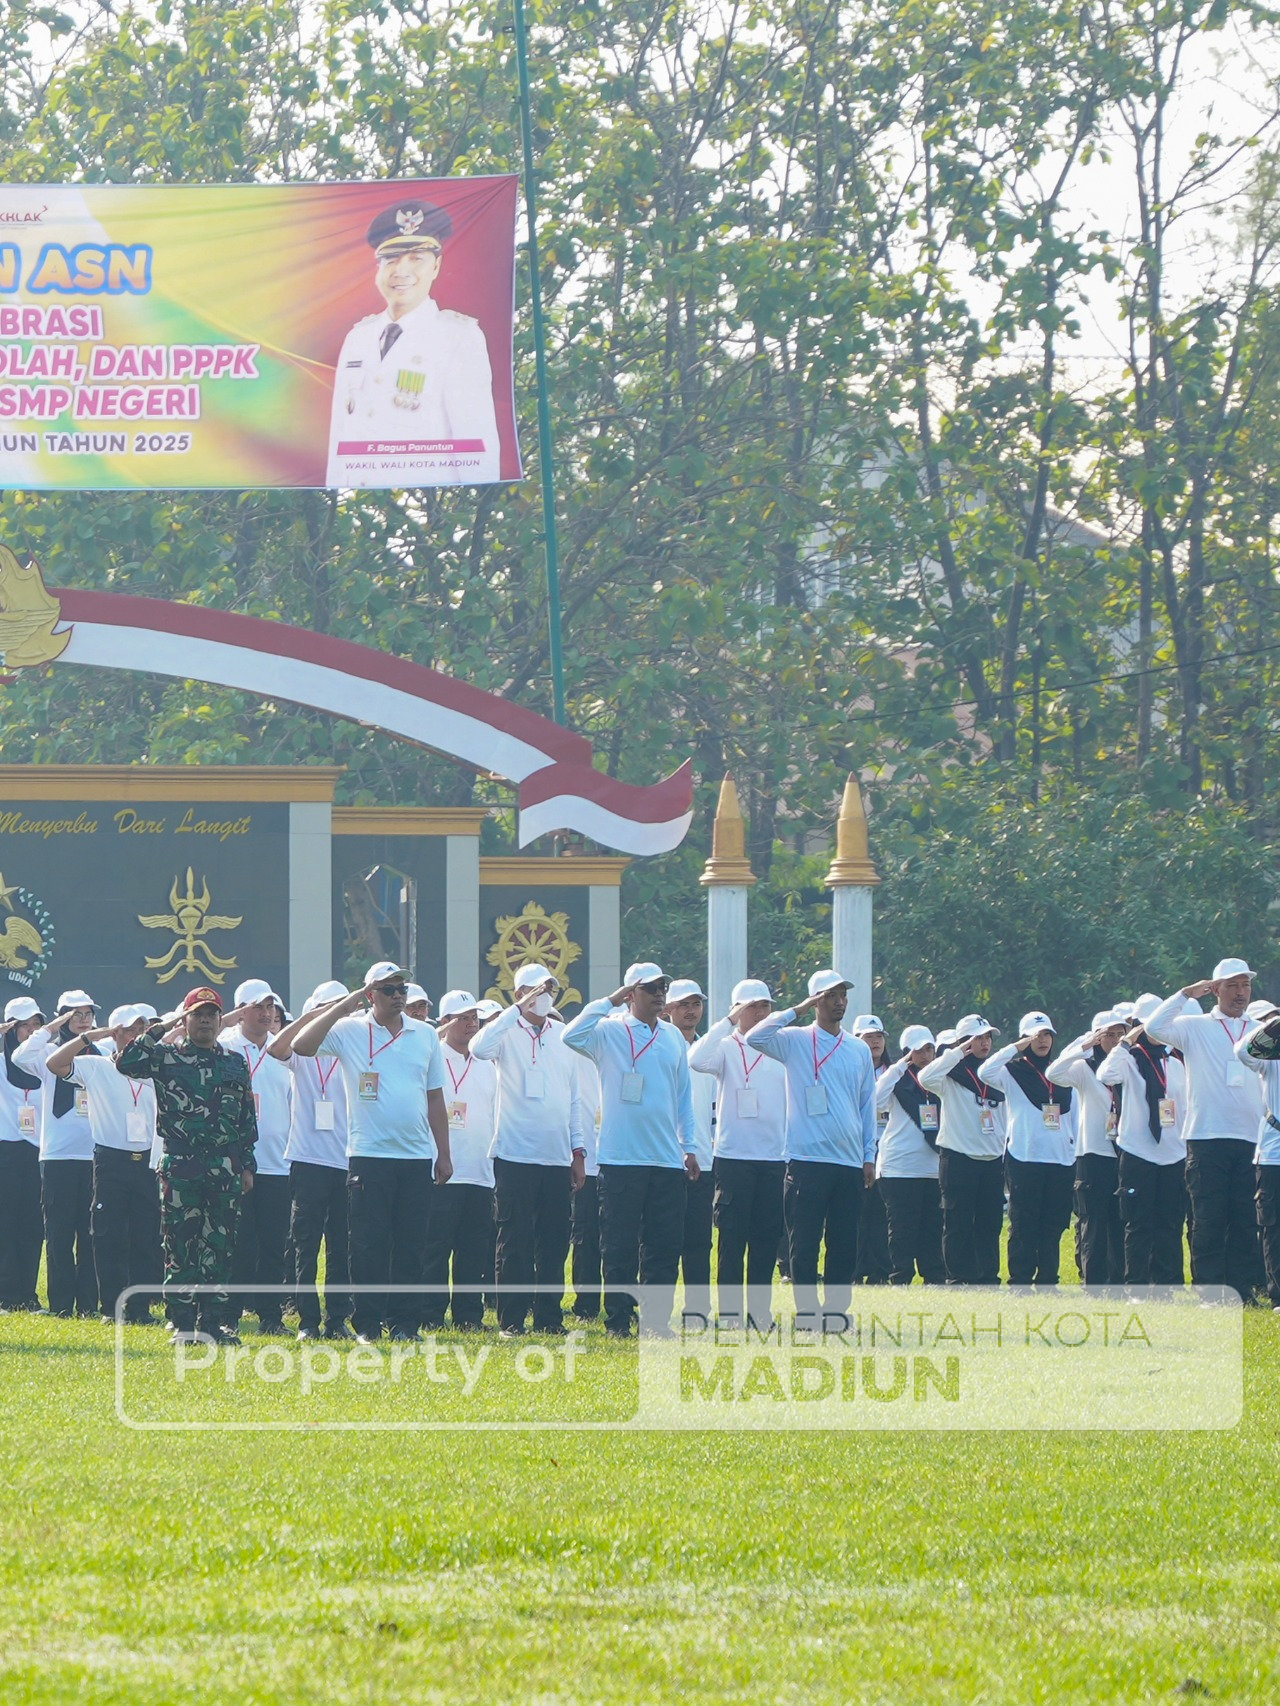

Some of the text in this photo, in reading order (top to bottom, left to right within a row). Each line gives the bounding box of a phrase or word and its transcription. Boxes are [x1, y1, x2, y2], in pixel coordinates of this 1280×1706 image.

[31, 248, 147, 290] ASN
[92, 349, 163, 377] DAN
[173, 348, 257, 376] PPPK
[76, 388, 196, 416] NEGERI
[45, 434, 125, 451] TAHUN
[134, 434, 190, 451] 2025
[377, 444, 406, 453] Bagus
[408, 443, 453, 451] Panuntun
[381, 461, 406, 469] WALI
[409, 460, 436, 468] KOTA
[439, 459, 480, 467] MADIUN
[113, 808, 167, 833] Dari
[174, 807, 252, 842] Langit
[8, 971, 33, 988] UDHA
